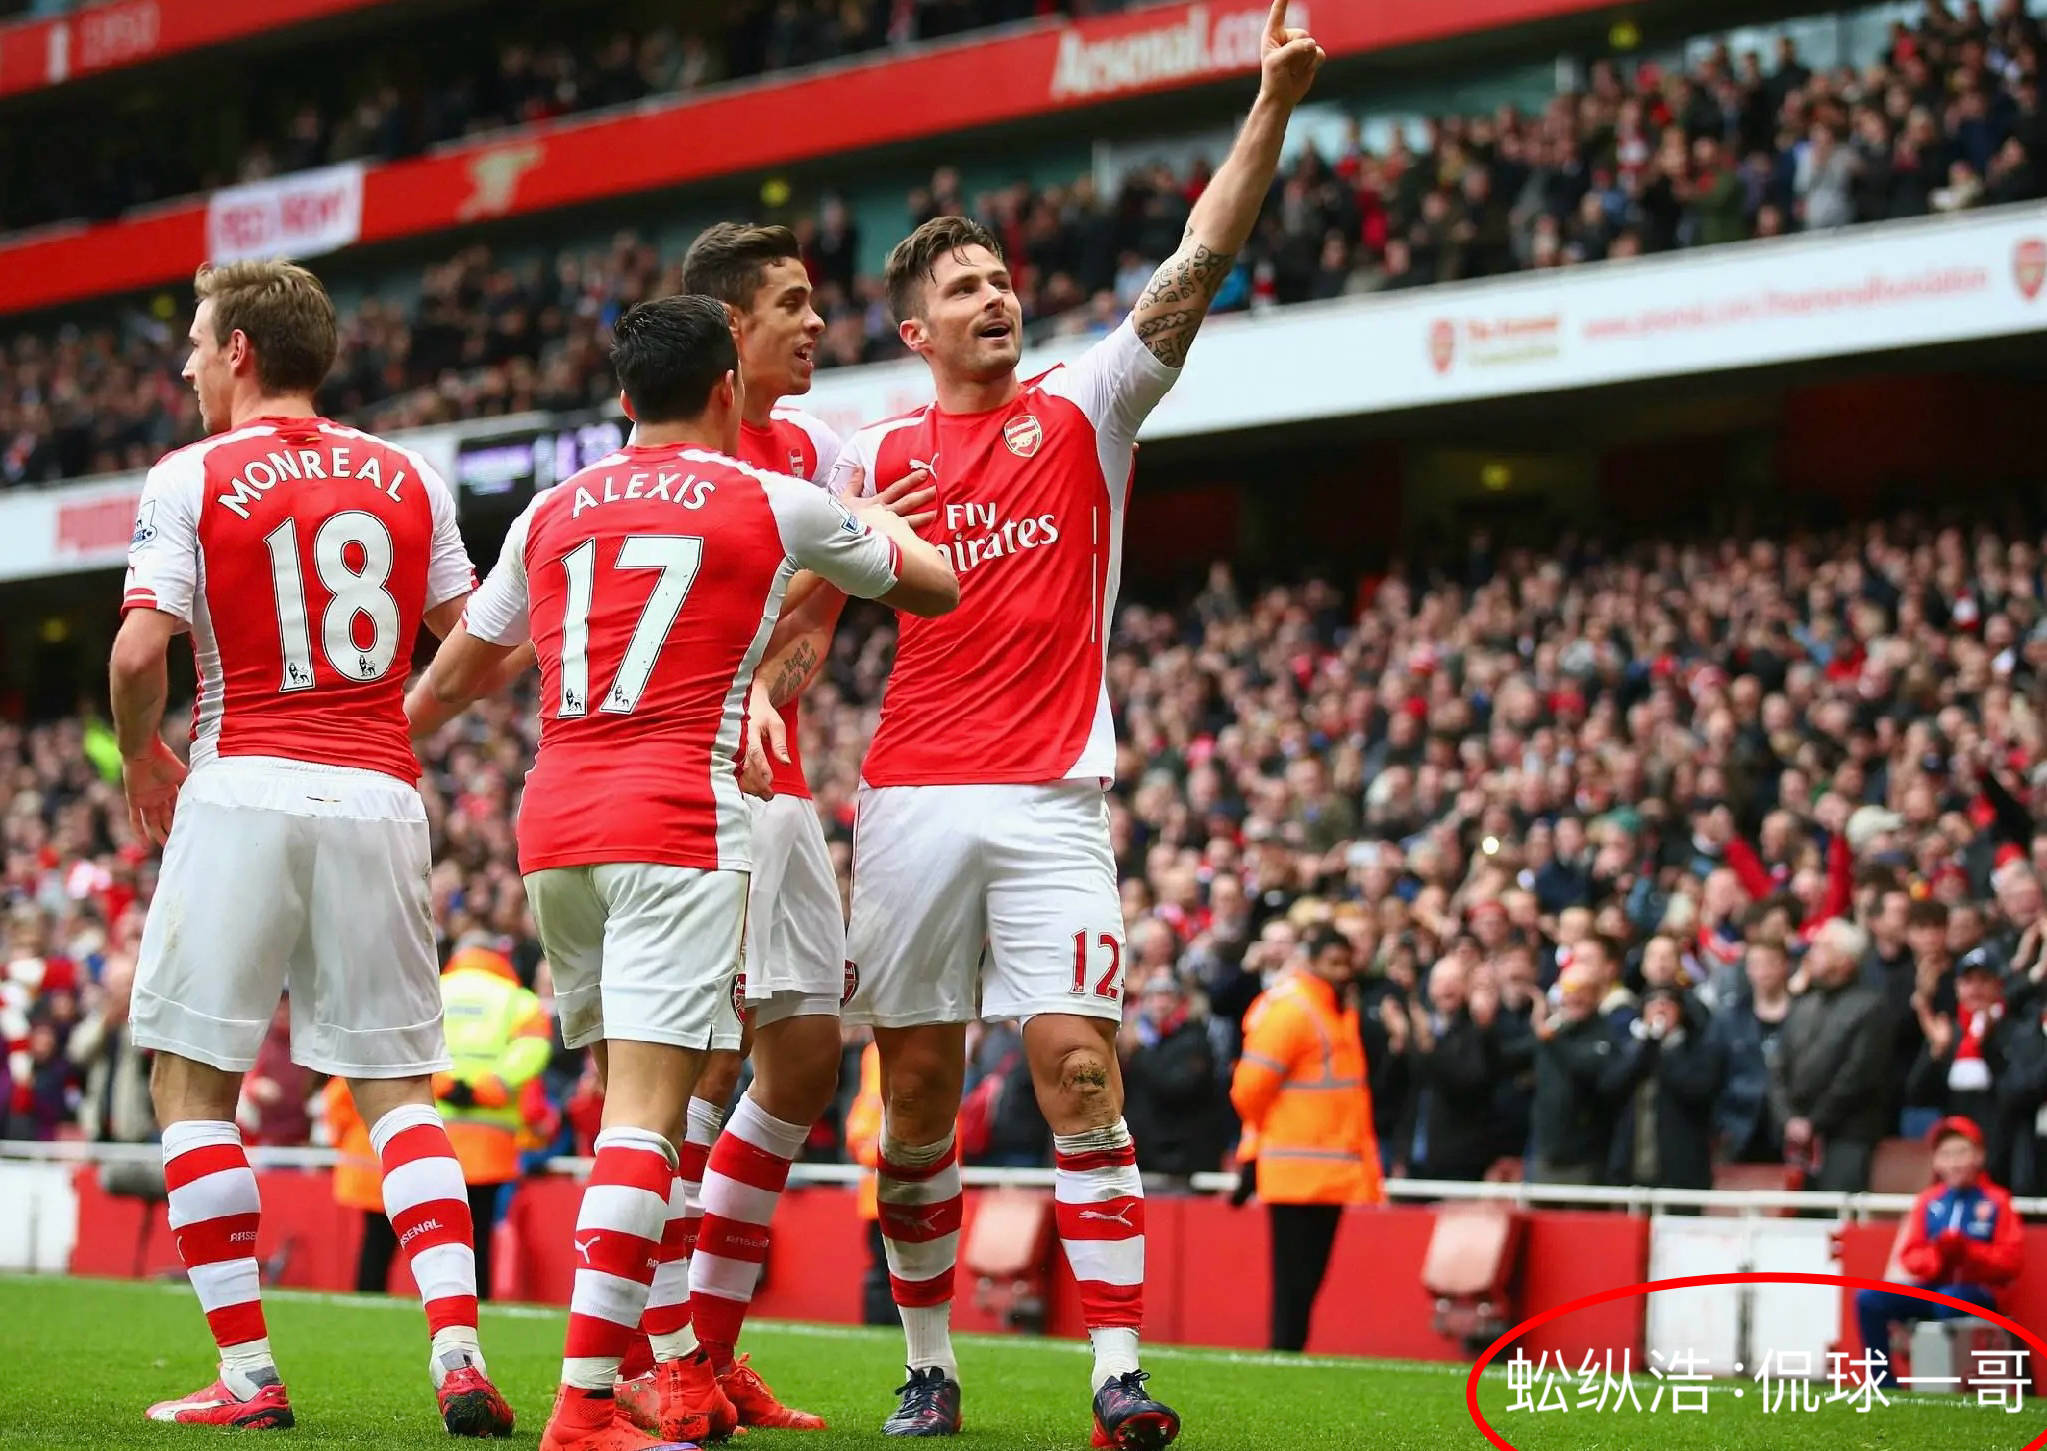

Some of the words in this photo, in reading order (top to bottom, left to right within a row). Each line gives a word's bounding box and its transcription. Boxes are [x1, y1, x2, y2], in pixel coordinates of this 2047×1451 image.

[217, 447, 406, 519] MONREAL
[572, 472, 716, 519] ALEXIS
[946, 502, 996, 530] Fly
[935, 513, 1059, 573] irates
[263, 510, 400, 692] 18
[557, 535, 704, 717] 17
[1069, 928, 1120, 1001] 12
